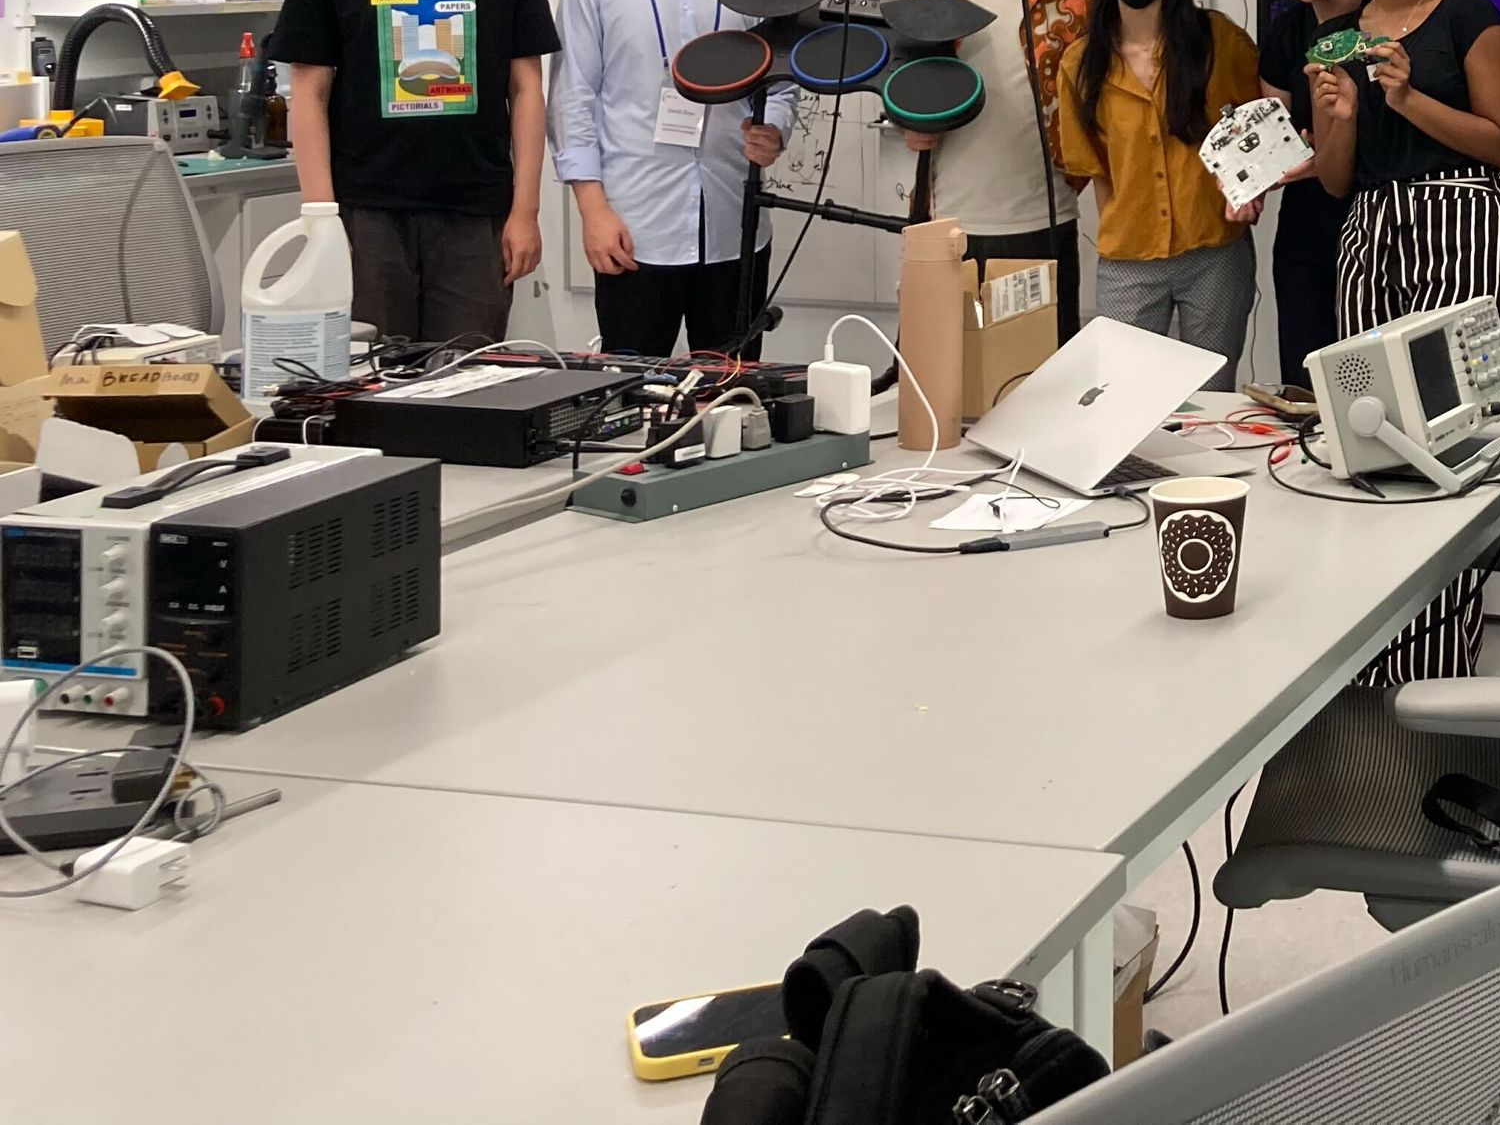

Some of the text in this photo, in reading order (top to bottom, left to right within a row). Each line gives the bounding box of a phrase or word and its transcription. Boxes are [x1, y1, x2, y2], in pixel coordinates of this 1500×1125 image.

[440, 2, 471, 11] PAPERS
[430, 85, 472, 95] ARTWORKS
[391, 102, 439, 112] PICTORIALS
